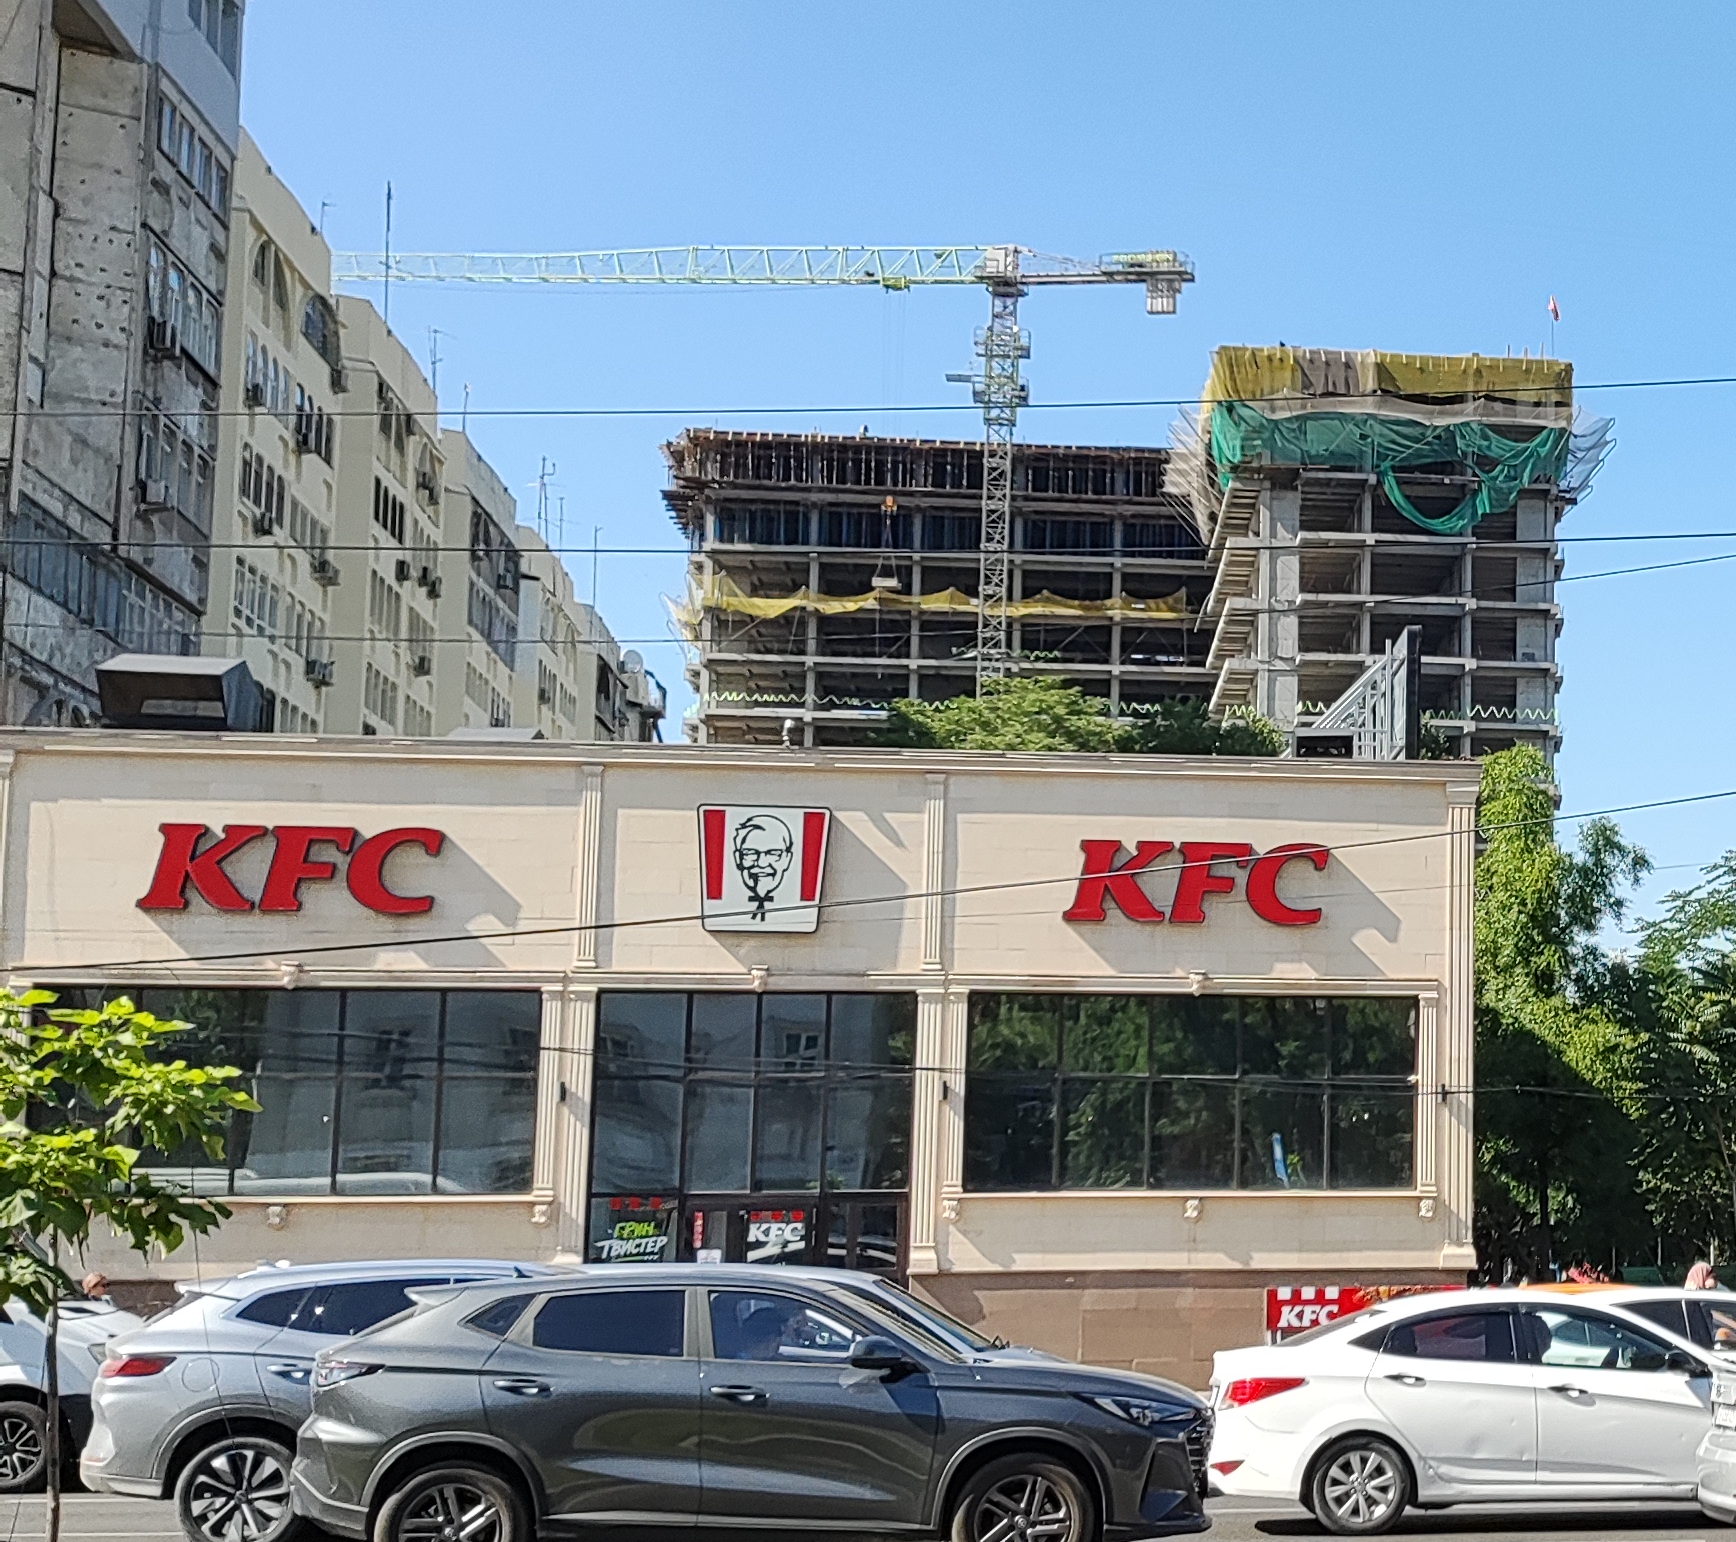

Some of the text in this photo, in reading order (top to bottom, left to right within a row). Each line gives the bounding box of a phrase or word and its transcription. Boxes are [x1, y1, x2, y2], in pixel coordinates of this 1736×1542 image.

[136, 823, 444, 915] KFC
[1062, 839, 1329, 926] KFC
[747, 1222, 803, 1242] KFC
[594, 1235, 668, 1260] ТВИСТЕР
[1277, 1305, 1339, 1328] KFC
